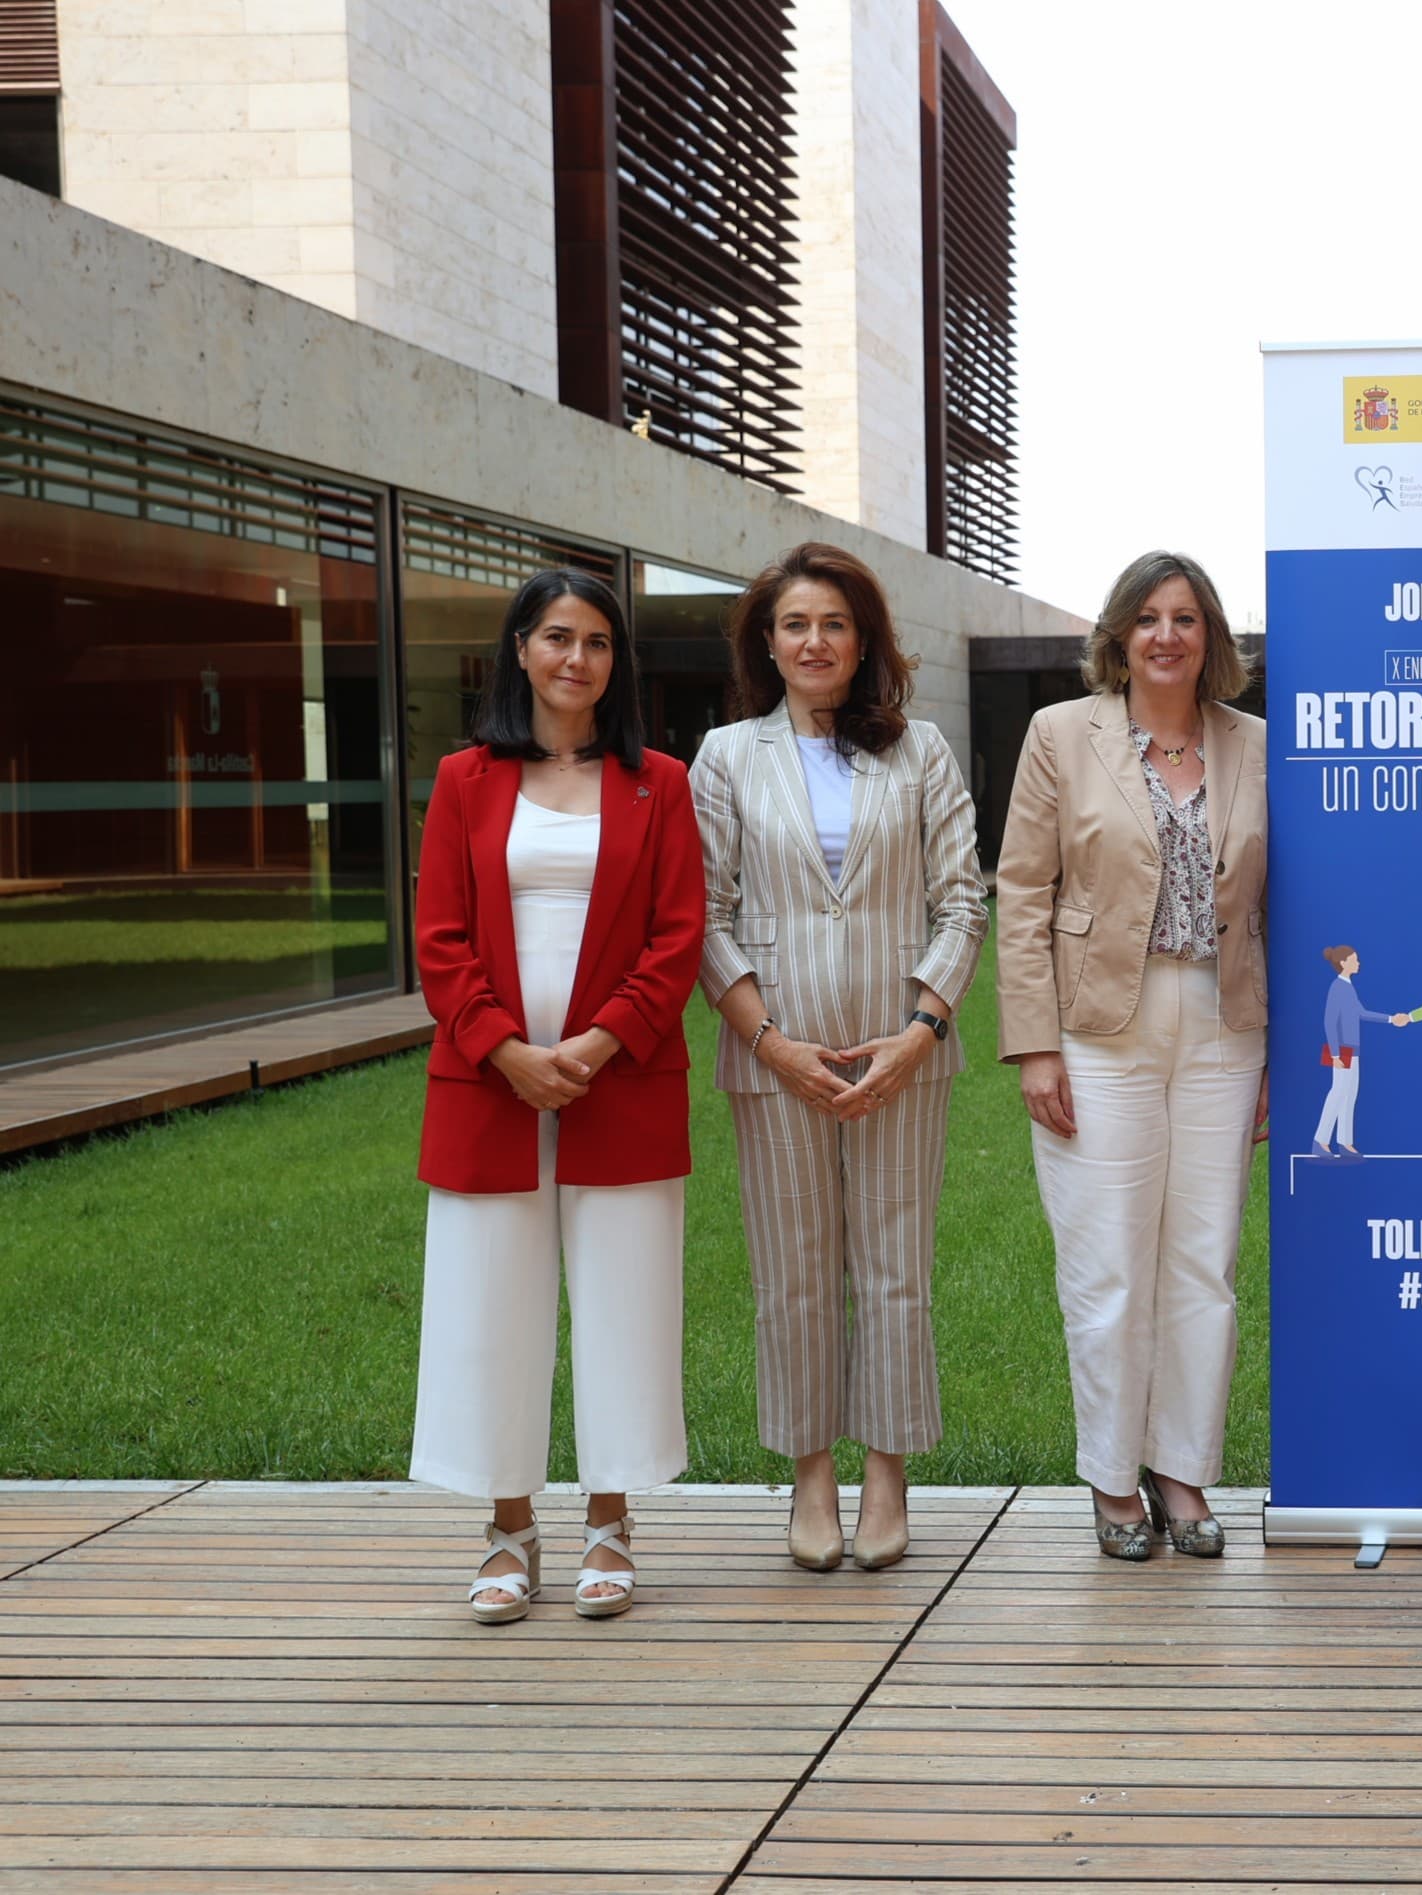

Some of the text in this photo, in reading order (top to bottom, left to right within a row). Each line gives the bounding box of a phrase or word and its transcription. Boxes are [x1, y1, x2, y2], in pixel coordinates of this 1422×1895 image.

[1407, 408, 1419, 416] DE
[1392, 656, 1400, 680] X
[1323, 765, 1359, 812] un
